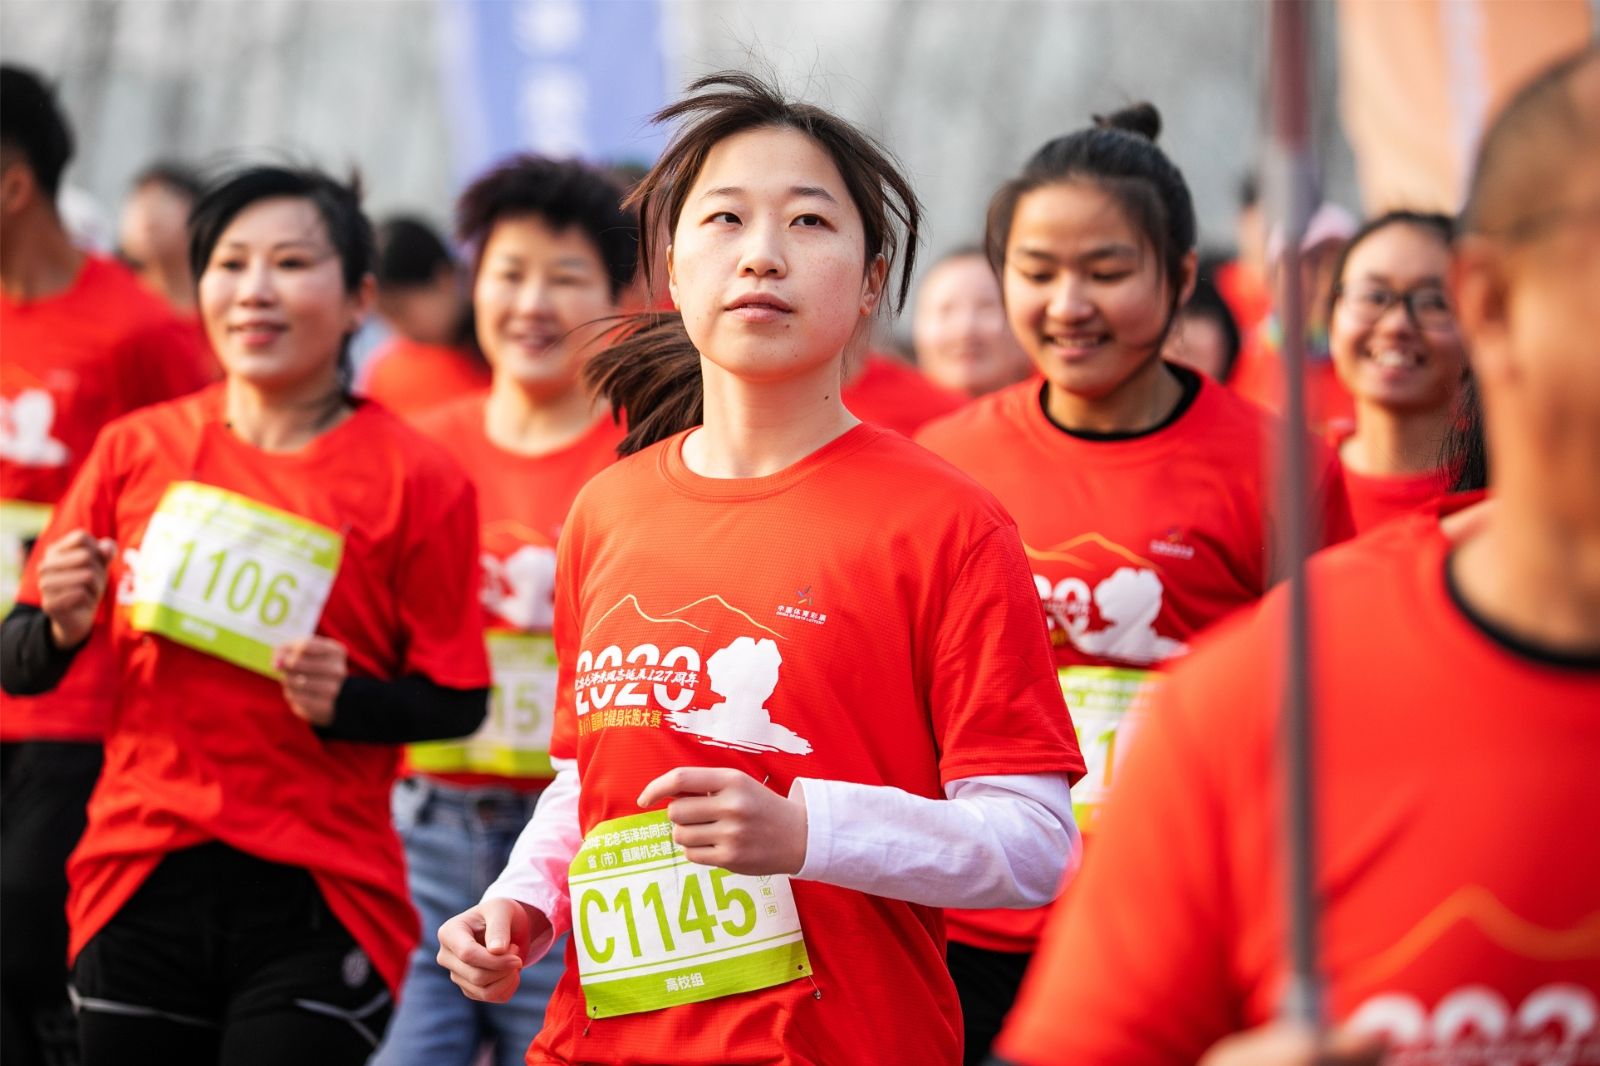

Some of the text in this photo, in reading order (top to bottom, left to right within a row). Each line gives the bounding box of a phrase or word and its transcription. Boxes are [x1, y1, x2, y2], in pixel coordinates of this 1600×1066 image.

[150, 534, 298, 628] 1106
[575, 643, 700, 716] 2020
[580, 868, 757, 964] C1145
[665, 972, 704, 992] 高校组
